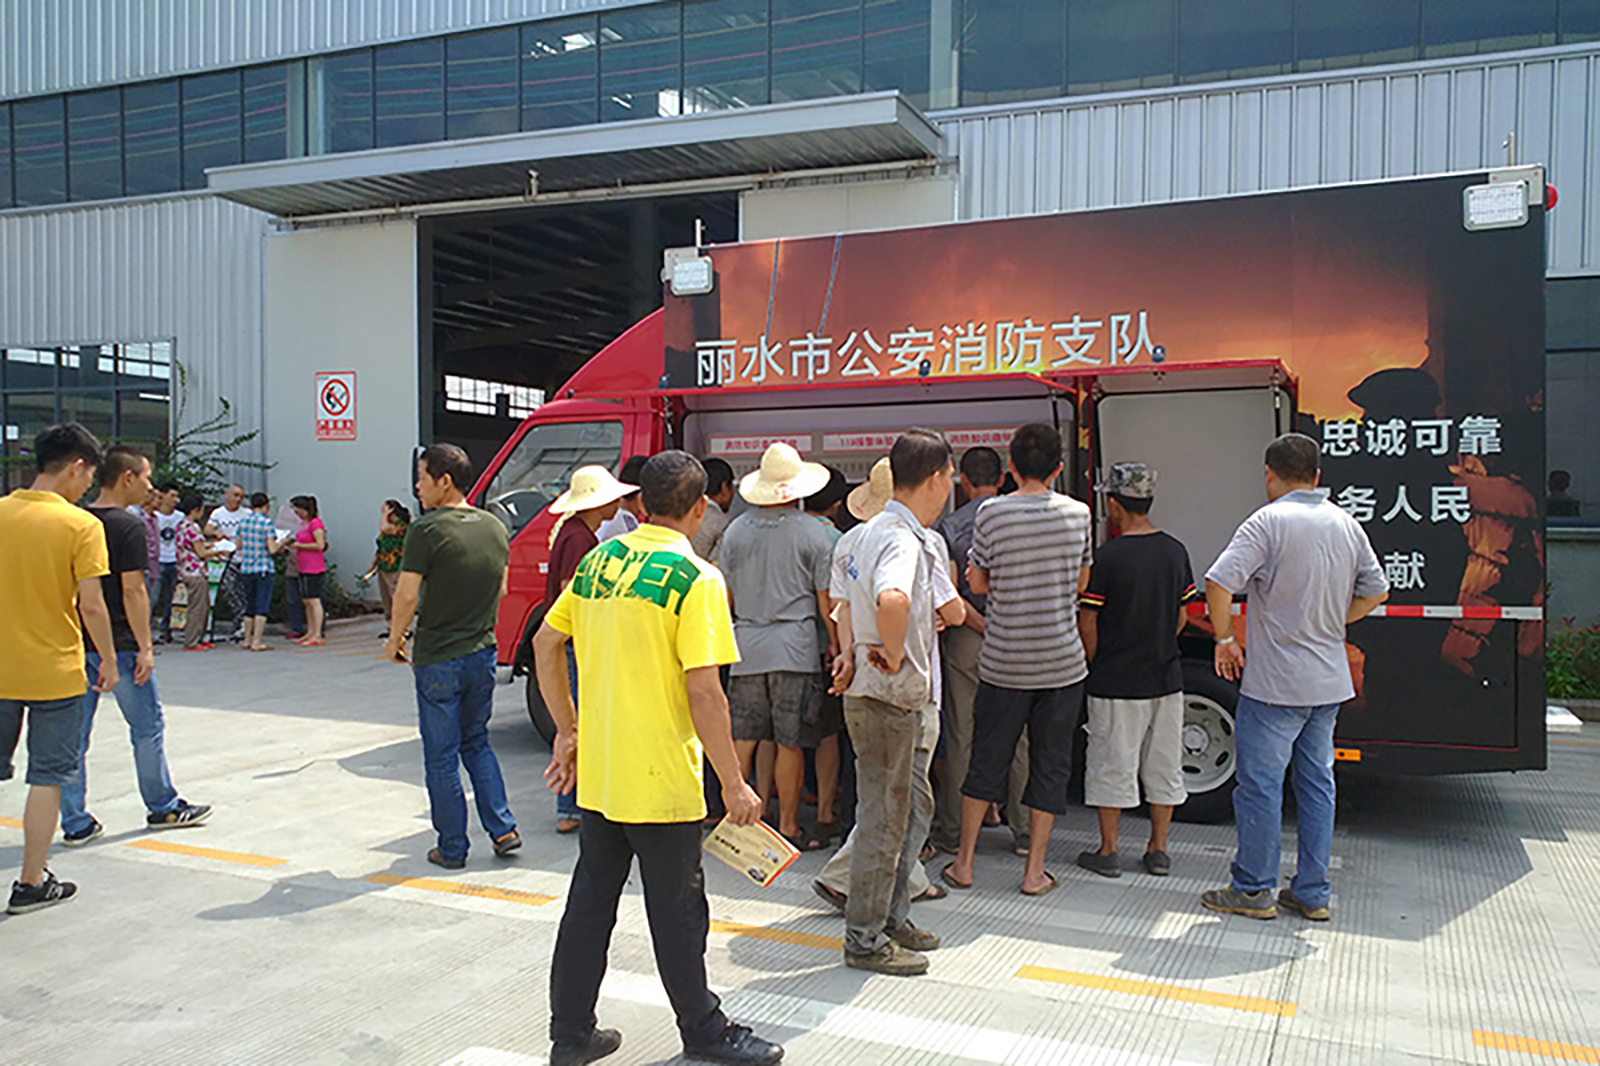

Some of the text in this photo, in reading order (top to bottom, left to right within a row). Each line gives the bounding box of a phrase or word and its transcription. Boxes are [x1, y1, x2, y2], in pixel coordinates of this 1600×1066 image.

[695, 311, 1155, 387] 丽水市公安消防支队
[1321, 415, 1502, 456] 忠诚可靠
